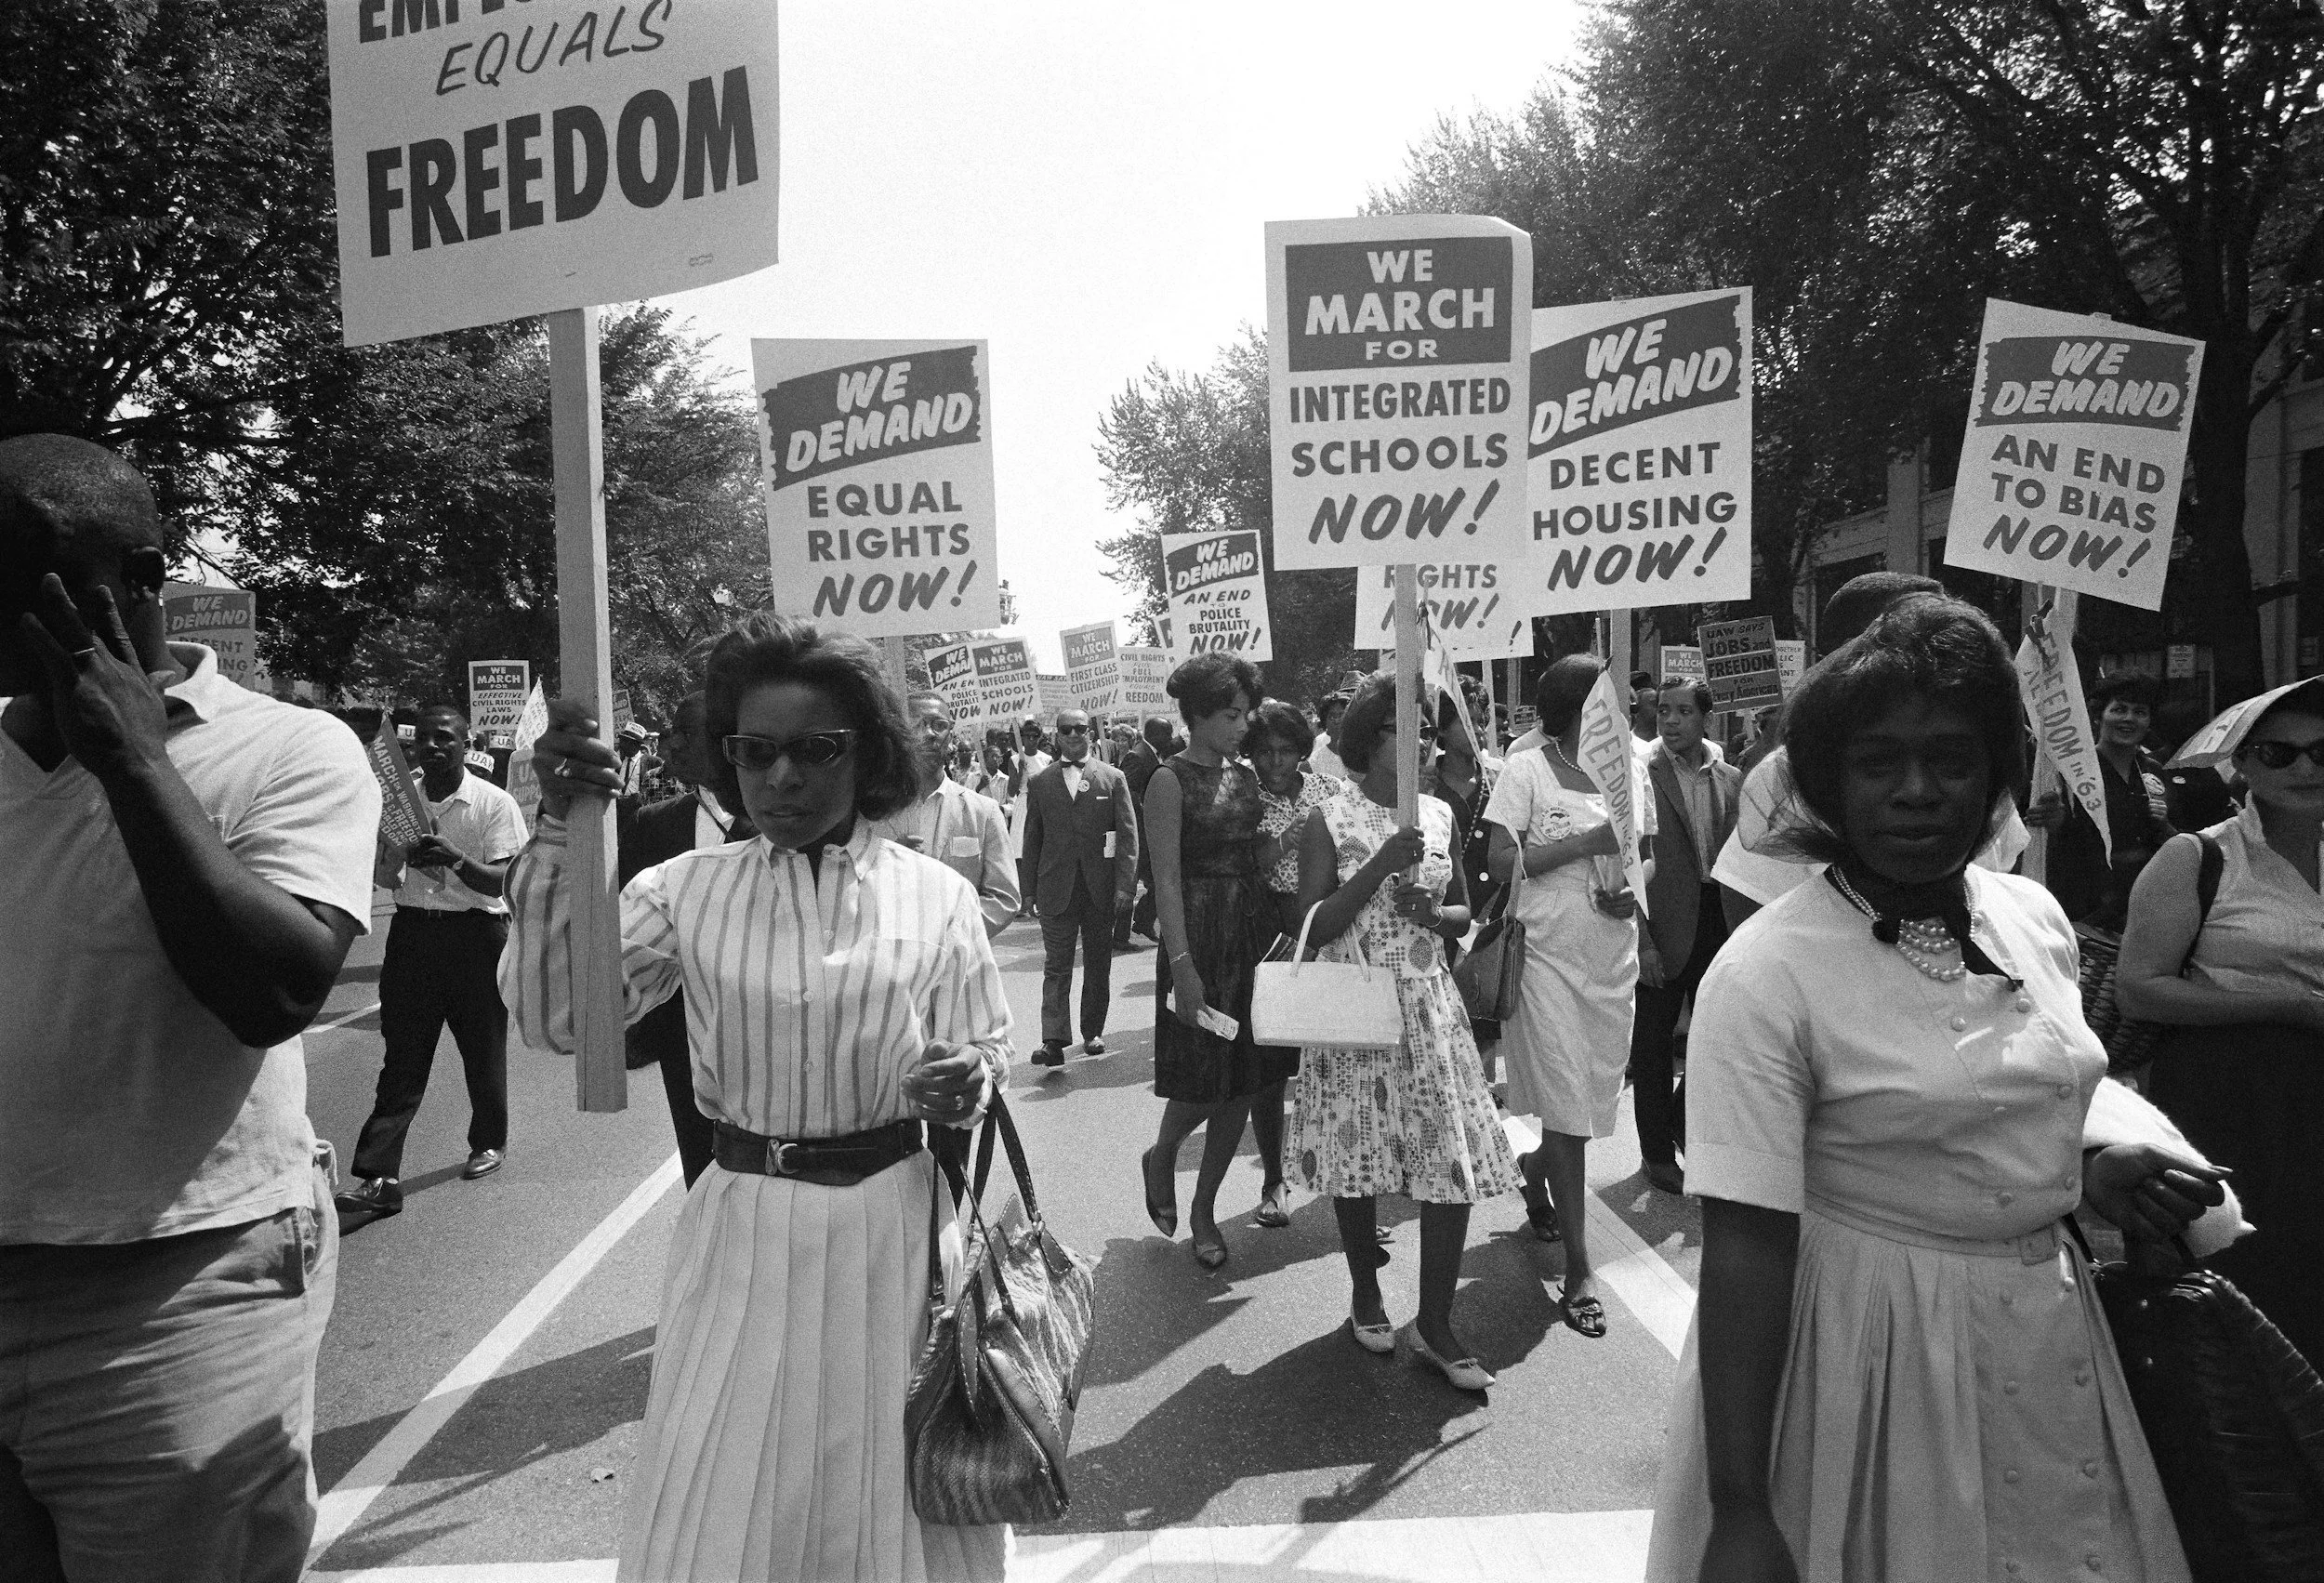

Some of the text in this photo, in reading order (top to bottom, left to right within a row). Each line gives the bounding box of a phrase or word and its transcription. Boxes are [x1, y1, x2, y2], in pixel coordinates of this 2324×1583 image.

[436, 0, 672, 95] EQUALS
[366, 65, 759, 257] FREEDOM
[1367, 249, 1433, 284] WE
[1305, 287, 1495, 336] MARCH
[1366, 339, 1438, 361] FOR
[1586, 318, 1667, 379] WE
[2051, 340, 2131, 376] WE
[837, 362, 912, 413] WE
[1529, 346, 1733, 445] DEMAND
[1991, 378, 2180, 418] DEMAND
[1290, 377, 1511, 423] INTEGRATED
[786, 392, 973, 472] DEMAND
[1291, 432, 1508, 478] SCHOOLS
[1551, 442, 1721, 490] DECENT
[1990, 434, 2165, 494] AN END
[808, 481, 962, 518] EQUAL
[1308, 478, 1499, 545] NOW!
[1991, 471, 2157, 534] TO BIAS
[1534, 491, 1737, 541] HOUSING
[808, 522, 970, 562] RIGHTS
[1196, 538, 1229, 562] WE
[1983, 513, 2151, 578] NOW!
[1175, 551, 1254, 590] DEMAND
[1547, 526, 1727, 591] NOW!
[1384, 564, 1497, 588] RGHTS
[812, 560, 977, 618] NOW!
[1183, 589, 1250, 604] AN END
[192, 596, 224, 613] WE
[1200, 607, 1241, 621] POLICE
[1381, 593, 1499, 631] W!
[171, 609, 248, 631] DEMAND
[1189, 619, 1250, 634] BRUTALITY
[991, 645, 1007, 654] WE
[1071, 640, 1110, 658] MARCH
[1082, 632, 1096, 643] WE
[1189, 627, 1261, 654] NOW!
[1706, 637, 1750, 657] JOBS
[946, 648, 966, 665] WE
[979, 652, 1023, 668] MARCH
[994, 664, 1012, 672] FOR
[1084, 655, 1100, 664] FOR
[1141, 653, 1166, 662] RIGHTS
[1708, 654, 1775, 678] FREEDOM
[477, 674, 521, 684] MARCH
[935, 659, 971, 683] DEMA
[979, 671, 1031, 688] INTEGRATED
[1070, 662, 1117, 682] FIRST CLASS
[1122, 675, 1165, 684] MPLOYMENT
[941, 679, 975, 692] AN EN
[951, 689, 978, 700] POLICE
[982, 684, 1034, 700] SCHOOLS
[1070, 674, 1120, 694] CITIZENSHIP
[947, 697, 980, 708] BRUTALIT
[989, 694, 1034, 716] NOW!
[1080, 688, 1118, 711] NOW!
[1125, 692, 1164, 704] REEDOM
[478, 713, 522, 726] NOW!
[949, 705, 981, 720] NOW
[1580, 699, 1630, 824] FREEDOM
[373, 734, 400, 784] MARCH
[397, 790, 422, 836] WASHINGTO
[2070, 762, 2084, 777] IN
[2077, 777, 2101, 811] '63
[381, 808, 398, 830] ORLD
[391, 808, 419, 844] FREEDO
